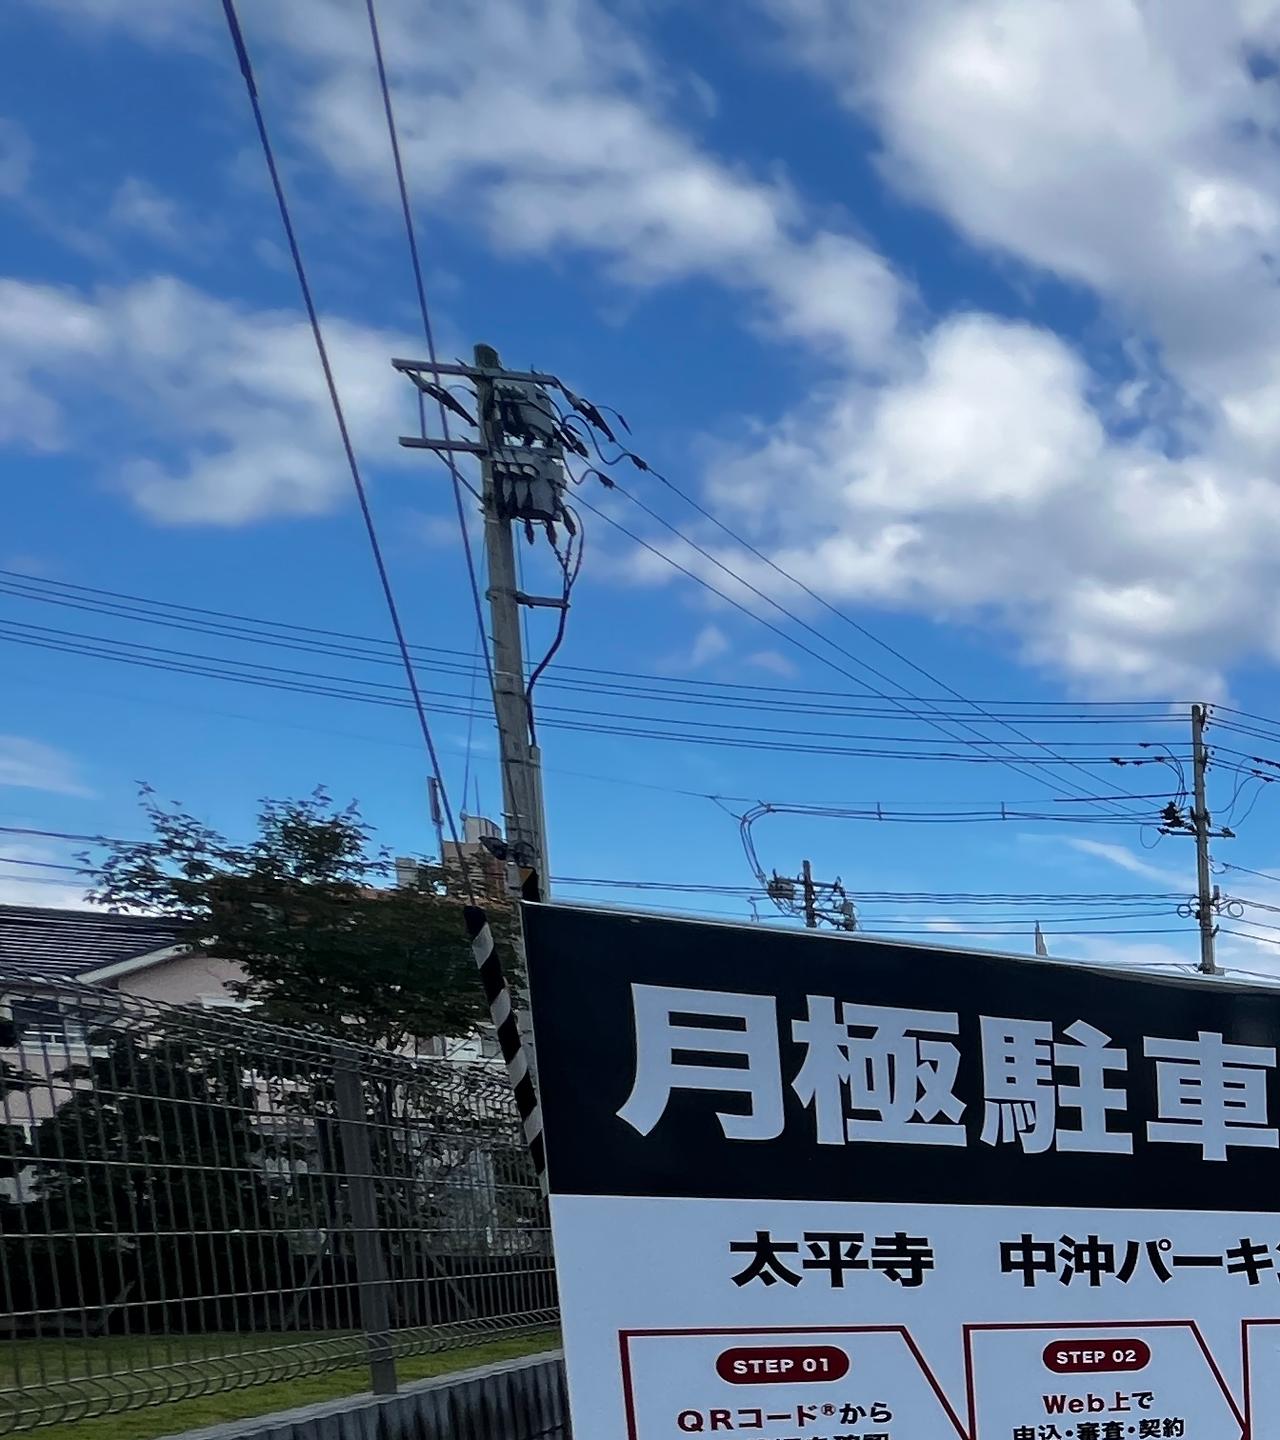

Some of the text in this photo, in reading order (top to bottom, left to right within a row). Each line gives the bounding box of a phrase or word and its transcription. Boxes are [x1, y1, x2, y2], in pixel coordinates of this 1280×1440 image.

[730, 1230, 935, 1288] 太平寺
[733, 1358, 830, 1375] STEP 01
[1056, 1349, 1137, 1365] STEP 02
[1042, 1391, 1155, 1415] Web上で
